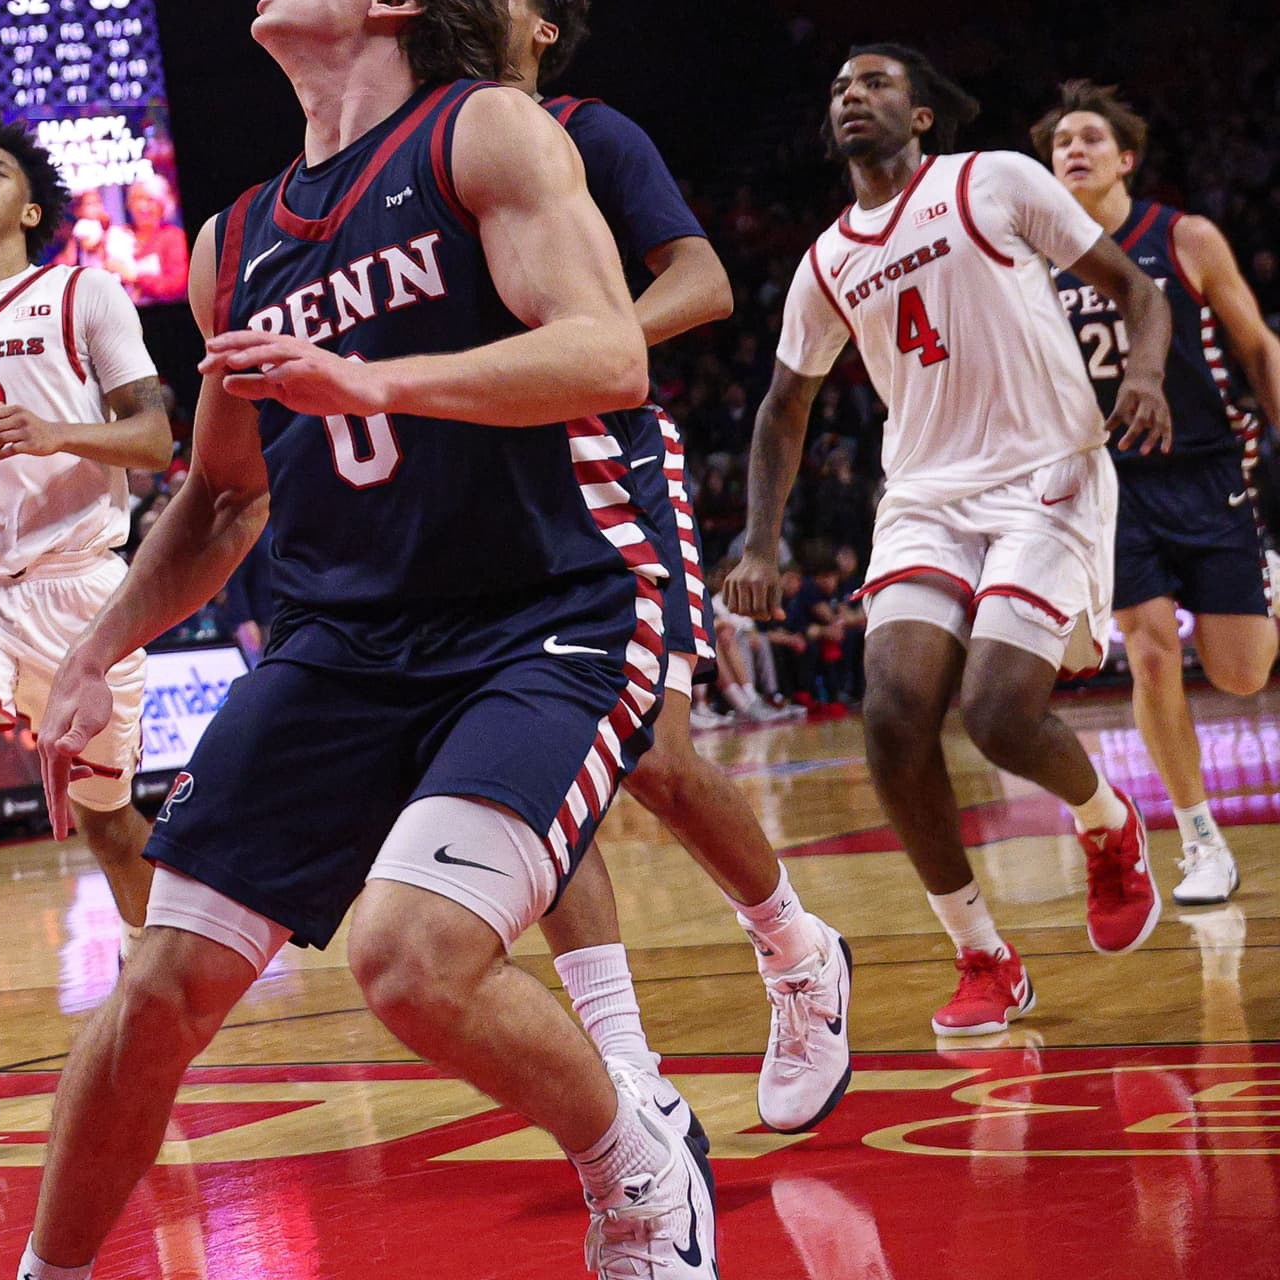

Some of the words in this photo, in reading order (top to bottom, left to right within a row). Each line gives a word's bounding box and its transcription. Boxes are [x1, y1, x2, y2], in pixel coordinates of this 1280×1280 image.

[246, 230, 449, 370] PENN
[845, 237, 952, 309] RUTGERS
[896, 287, 949, 367] 4
